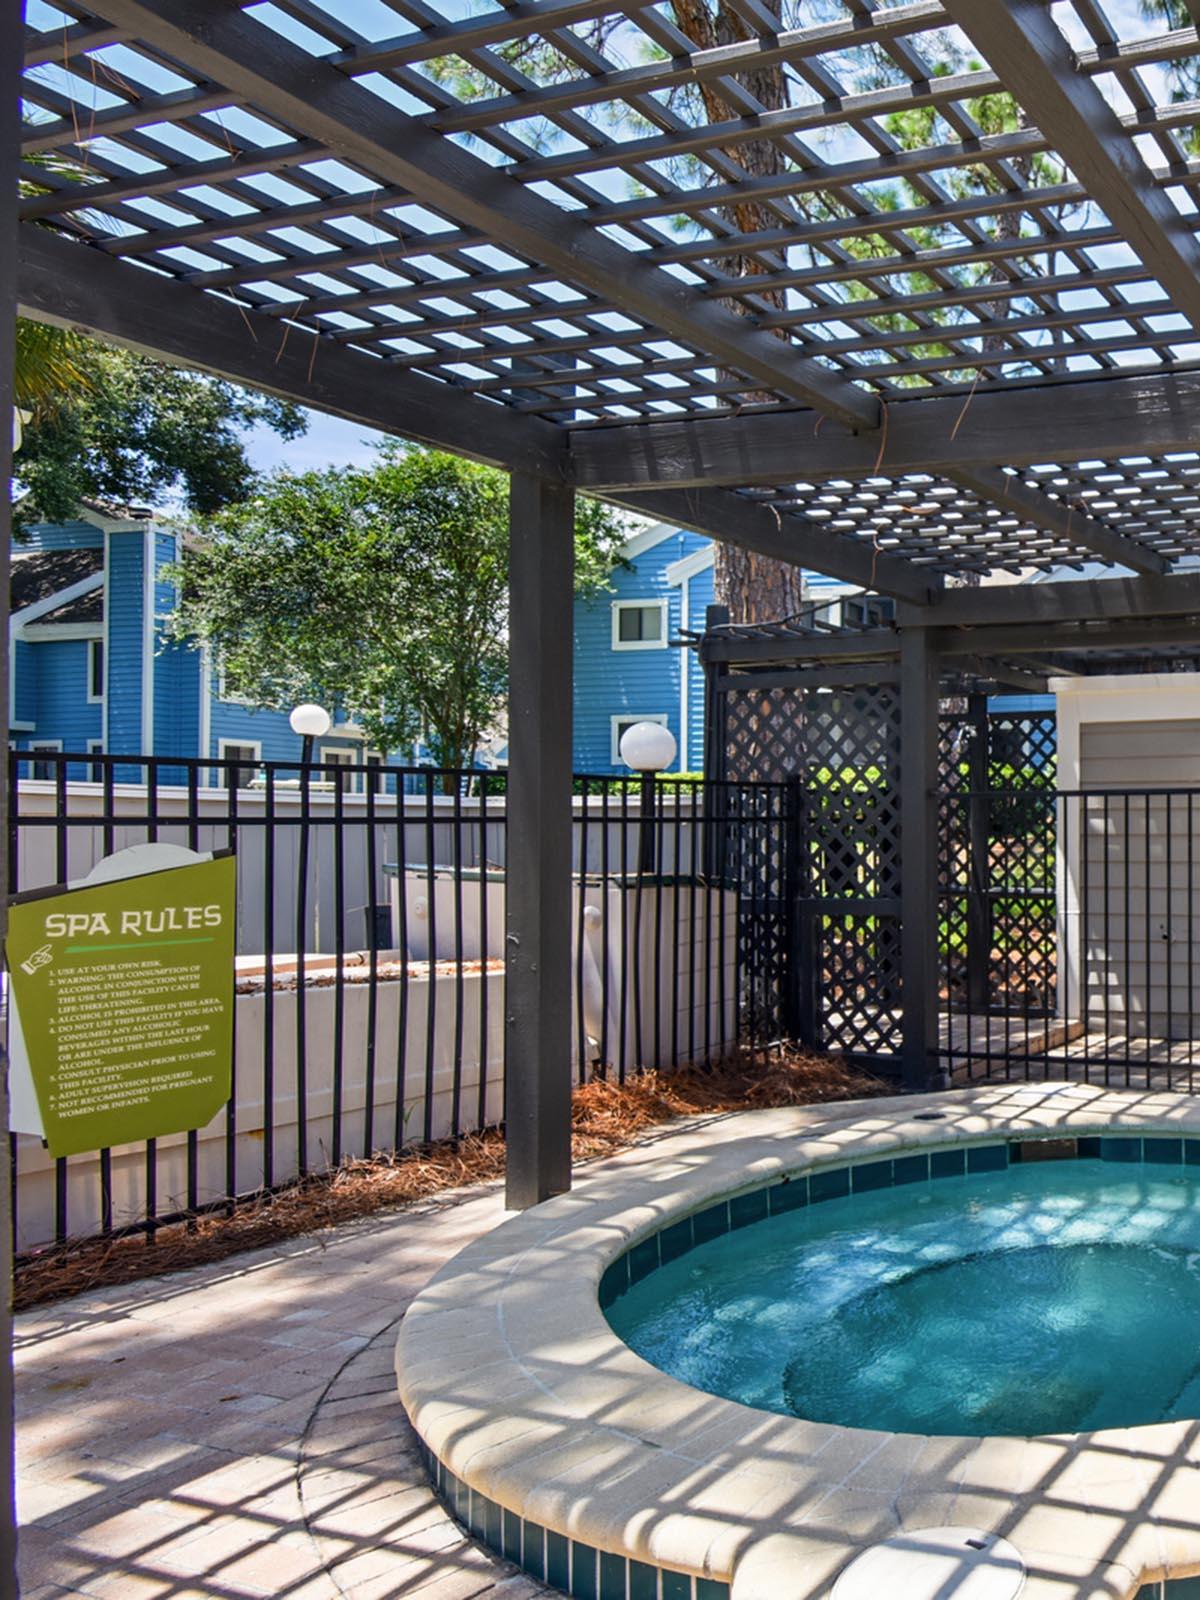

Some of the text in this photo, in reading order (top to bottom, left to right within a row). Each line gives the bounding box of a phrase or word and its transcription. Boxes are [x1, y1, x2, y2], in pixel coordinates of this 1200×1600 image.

[45, 905, 222, 938] SPA RULES
[126, 968, 188, 978] CONSUMPTION
[58, 985, 101, 994] ALCOHOL
[116, 976, 176, 988] CONJUNCTION
[132, 986, 168, 995] FACILITY
[58, 1012, 101, 1022] ALCOHOL
[114, 1004, 166, 1016] PROHIBITED
[136, 1012, 173, 1022] FACILITY
[202, 1006, 224, 1014] HAVE
[58, 1030, 111, 1042] CONSUMED
[132, 1020, 181, 1032] ALCOHOLIC
[58, 1040, 110, 1052] BEVERAGES
[112, 1034, 145, 1044] WITHIN
[164, 1028, 184, 1036] LAST
[186, 1024, 210, 1032] HOUR
[94, 1046, 124, 1056] UNDER
[144, 1037, 190, 1048] INFLUENCE
[58, 1068, 102, 1080] CONSULT
[103, 1060, 150, 1072] PHYSICIAN
[151, 1056, 176, 1065] PRIOR
[191, 1049, 216, 1059] USING
[58, 1082, 80, 1090] THIS
[59, 1088, 90, 1100] ADULT
[91, 1078, 150, 1092] SUPERVISION
[80, 1087, 150, 1104] RECOMMENDED
[152, 1084, 168, 1092] FOR
[169, 1076, 213, 1088] PREGNANT
[58, 1107, 95, 1118] WOMEN
